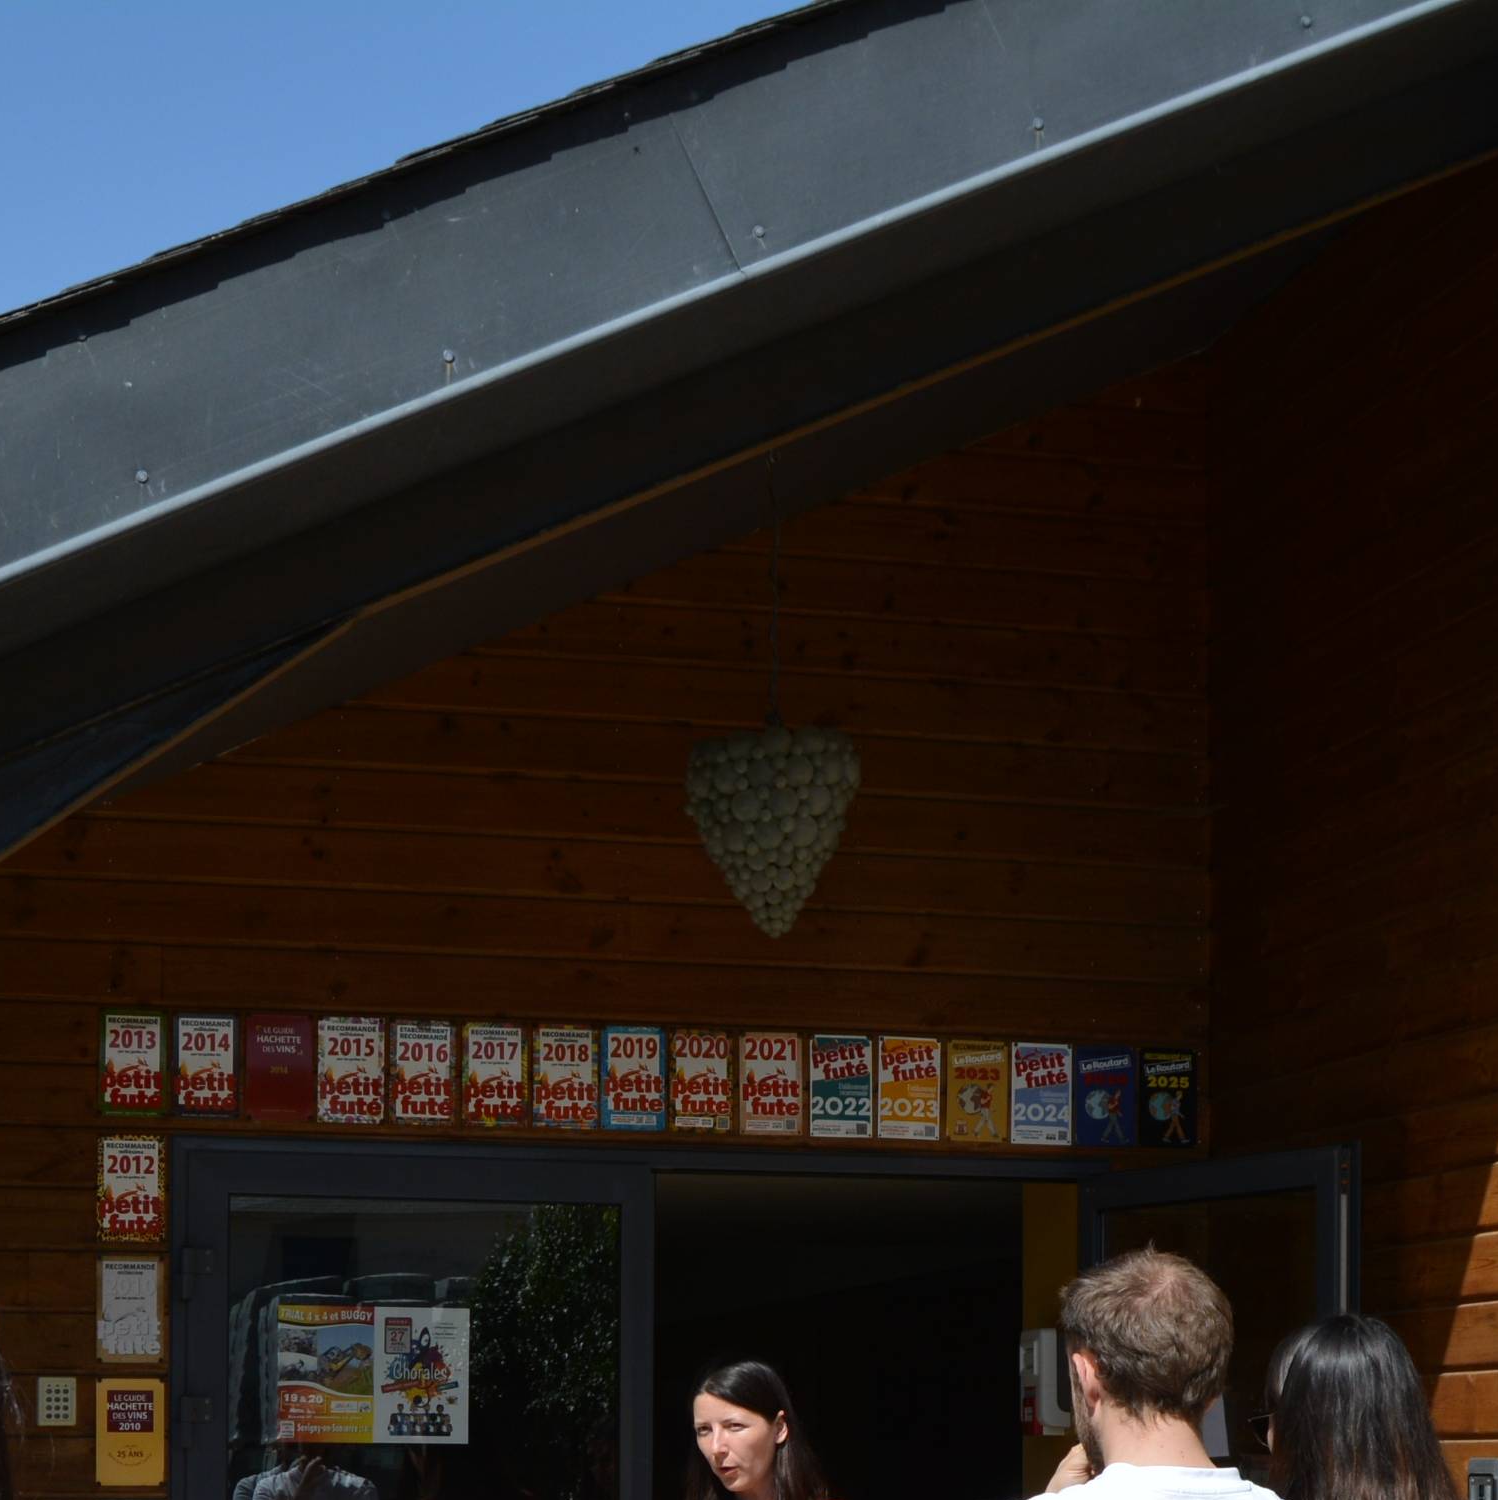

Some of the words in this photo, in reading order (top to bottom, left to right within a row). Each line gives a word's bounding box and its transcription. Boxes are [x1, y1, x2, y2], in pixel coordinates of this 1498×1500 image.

[108, 1029, 156, 1049] 2013
[182, 1032, 230, 1052] 2014
[256, 1034, 301, 1044] HACHETTE
[327, 1037, 375, 1057] 2015
[610, 1037, 658, 1059] 2019
[675, 1035, 728, 1058] 2020
[262, 1045, 275, 1053] DES
[276, 1045, 296, 1054] VINS
[398, 1042, 449, 1063] 2016
[472, 1042, 518, 1060] 2017
[542, 1043, 589, 1062] 2018
[745, 1038, 797, 1061] 2021
[812, 1043, 866, 1068] petit
[881, 1046, 934, 1070] petit
[955, 1056, 964, 1065] Le
[965, 1052, 1003, 1063] Routard
[823, 1060, 868, 1081] futé
[892, 1065, 938, 1083] futé
[954, 1067, 1000, 1081] 2023
[1015, 1053, 1066, 1077] petit
[1081, 1062, 1092, 1071] Le
[1093, 1057, 1129, 1069] Routard
[1146, 1065, 1155, 1073] Le
[1156, 1061, 1190, 1073] Routard
[101, 1070, 163, 1092] petit
[174, 1072, 236, 1095] petit
[320, 1077, 382, 1099] petit
[392, 1077, 453, 1099] petit
[604, 1074, 662, 1096] petit
[672, 1077, 732, 1098] petit
[1025, 1069, 1068, 1089] futé
[1147, 1076, 1190, 1088] 2025
[464, 1080, 525, 1103] petit
[535, 1082, 596, 1104] petit
[742, 1079, 800, 1101] petit
[812, 1096, 870, 1116] 2022
[881, 1097, 939, 1118] 2023
[1014, 1103, 1070, 1122] 2024
[107, 1155, 154, 1174] 2012
[100, 1195, 162, 1218] petit
[322, 1311, 328, 1320] 4
[329, 1312, 339, 1320] et
[340, 1309, 373, 1321] BUGGY
[390, 1331, 405, 1342] 27
[393, 1360, 448, 1380] Chorales
[107, 1402, 154, 1411] HACHETTE
[123, 1394, 146, 1402] GUIDE
[283, 1393, 298, 1404] 19
[308, 1395, 324, 1405] 20
[112, 1411, 126, 1419] DES
[127, 1411, 148, 1420] VINS
[118, 1422, 141, 1431] 2010
